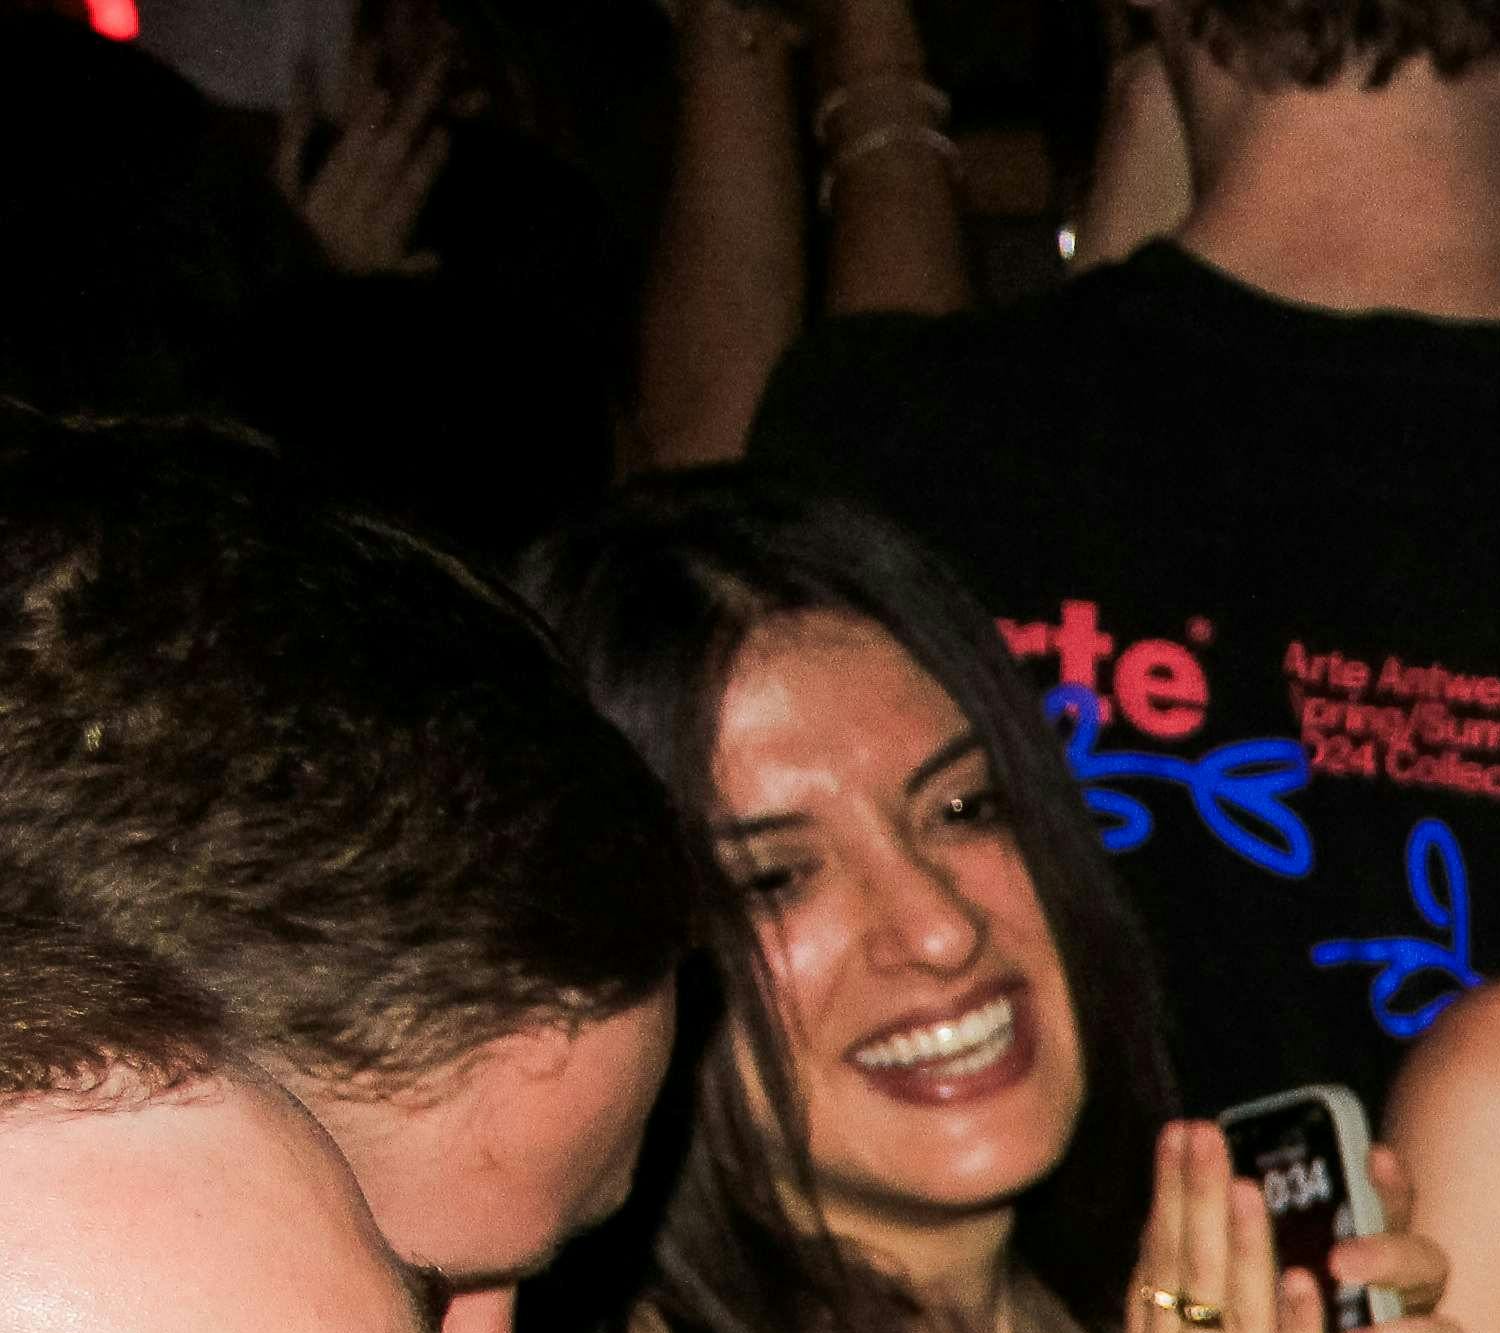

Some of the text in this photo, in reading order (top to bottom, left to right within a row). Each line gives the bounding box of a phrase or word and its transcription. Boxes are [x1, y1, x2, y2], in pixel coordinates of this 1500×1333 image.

[996, 600, 1208, 739] rte
[1285, 642, 1371, 689] Arte
[1304, 732, 1377, 776] 024
